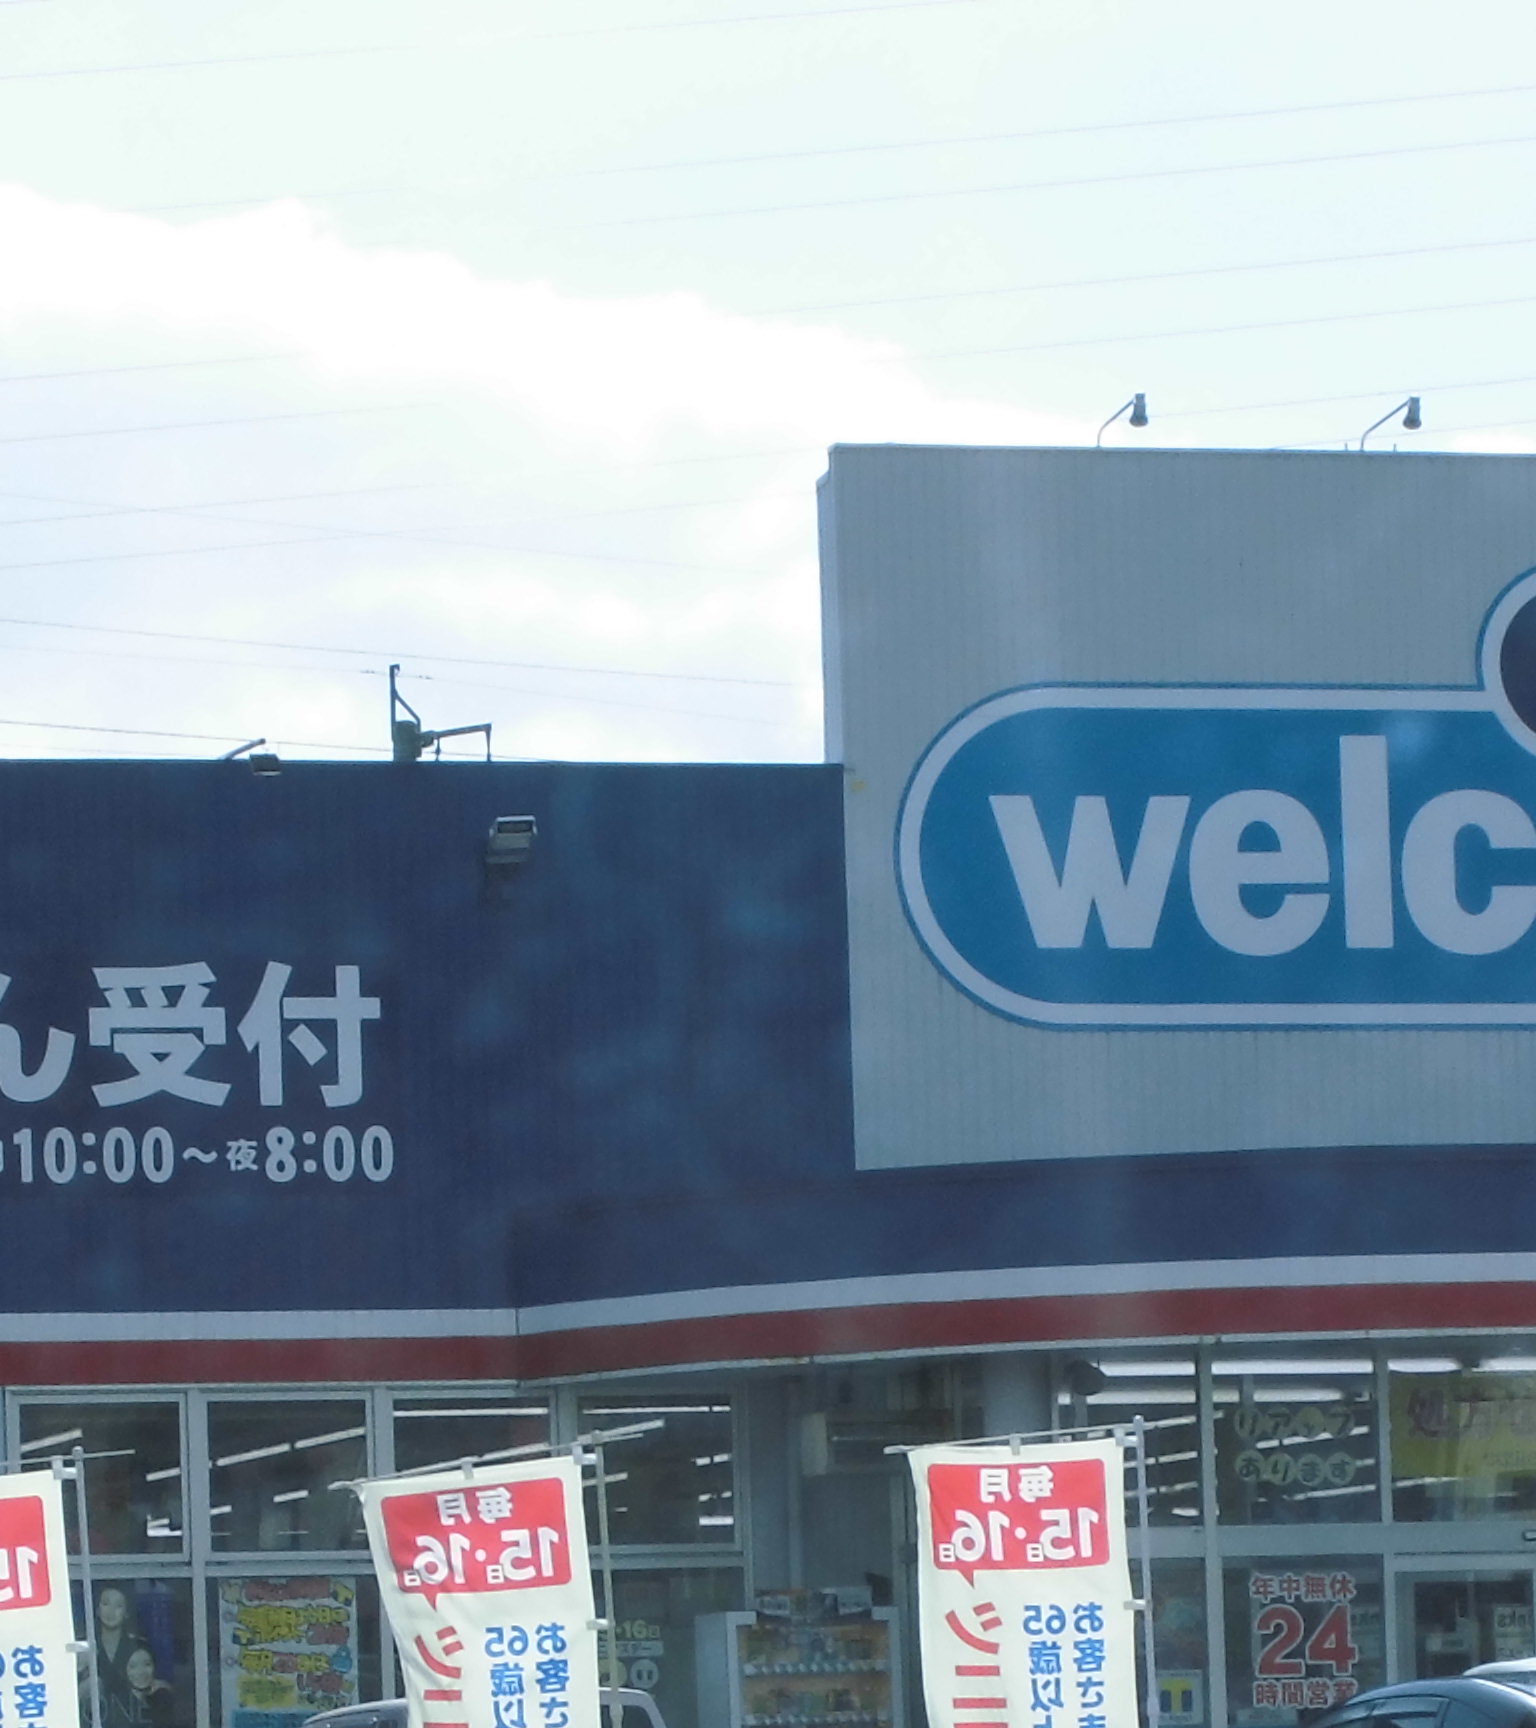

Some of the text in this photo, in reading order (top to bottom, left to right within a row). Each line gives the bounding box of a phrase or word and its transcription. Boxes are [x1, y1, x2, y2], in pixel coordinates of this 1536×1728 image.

[1250, 1572, 1357, 1602] 年中無休
[1255, 1603, 1359, 1678] 24
[1253, 1679, 1359, 1708] 時間営業
